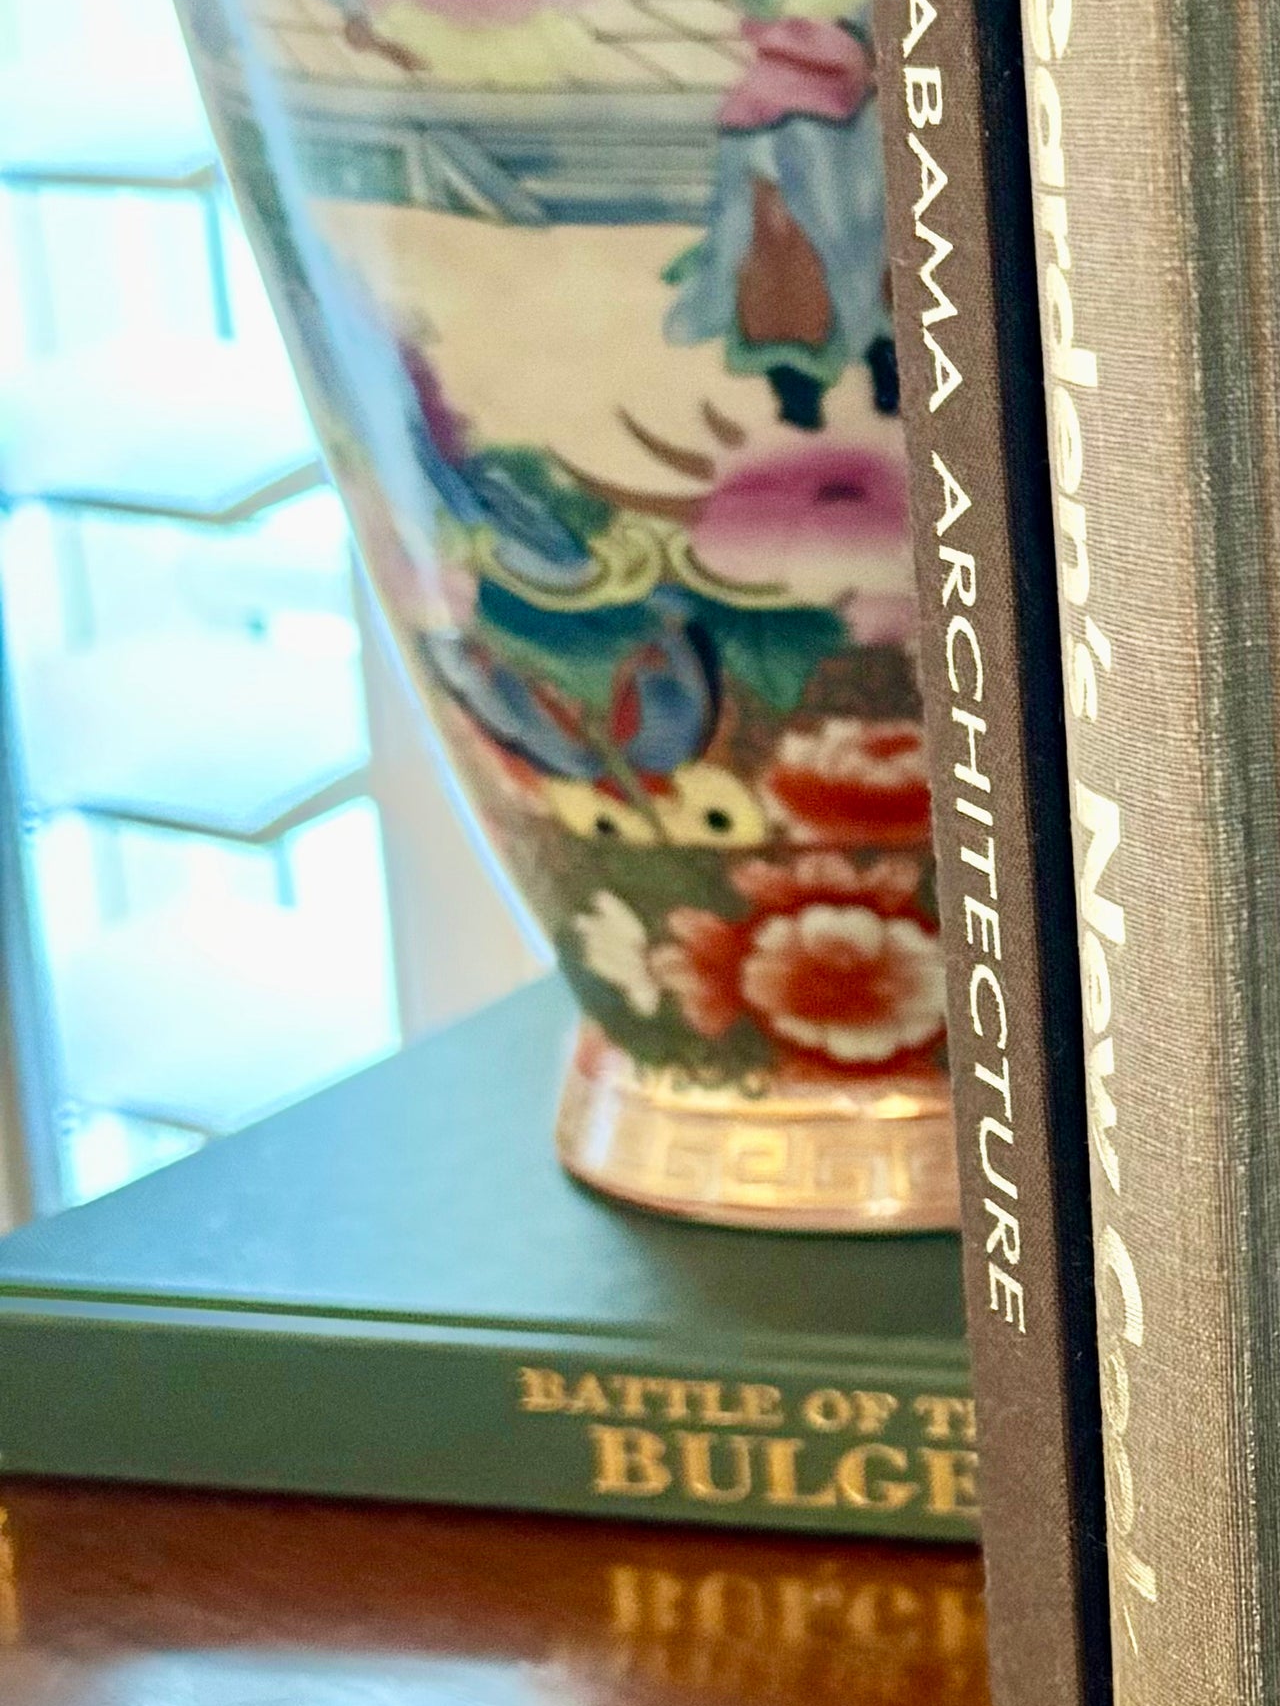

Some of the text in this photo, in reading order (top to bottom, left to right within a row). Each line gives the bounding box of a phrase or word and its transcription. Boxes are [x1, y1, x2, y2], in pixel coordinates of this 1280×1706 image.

[930, 449, 1027, 1335] ARCHITECTURE
[1073, 778, 1126, 1196] New
[517, 1366, 785, 1429] BATTLE
[804, 1388, 900, 1436] OF
[587, 1424, 981, 1519] BULGE
